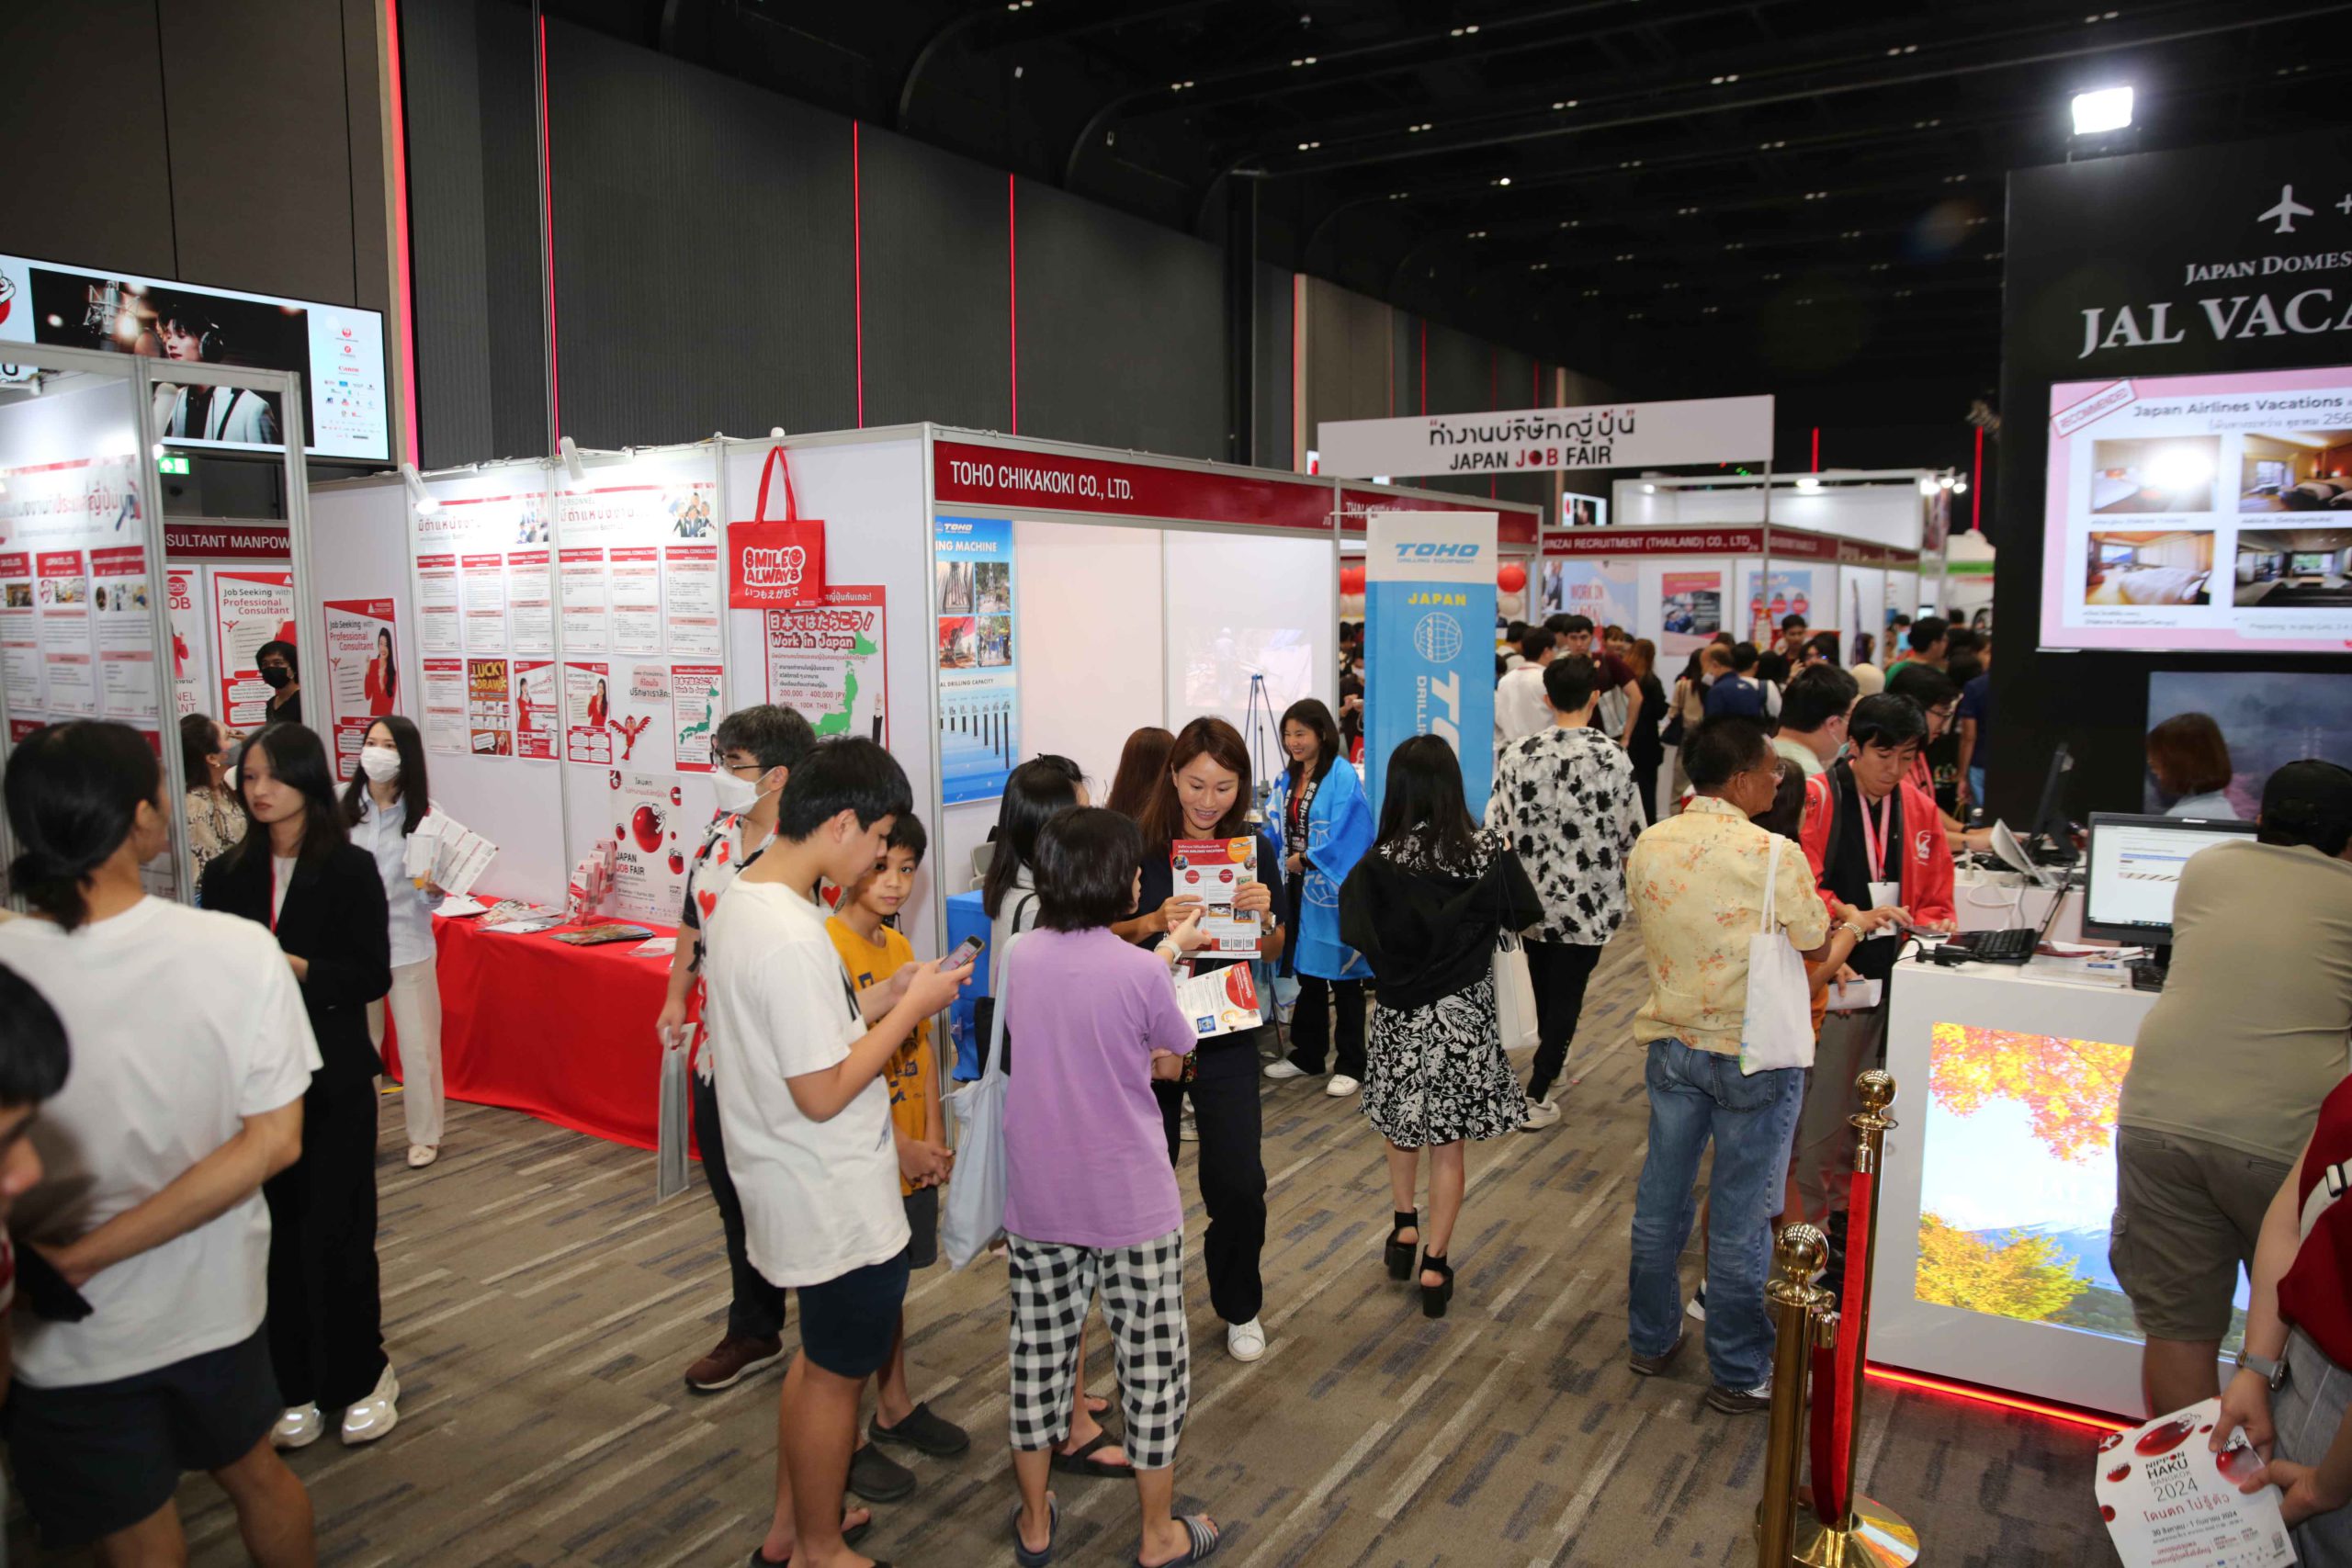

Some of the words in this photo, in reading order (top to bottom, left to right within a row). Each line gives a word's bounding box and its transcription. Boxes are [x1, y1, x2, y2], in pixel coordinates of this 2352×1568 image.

[2185, 261, 2256, 286] JAPAN
[2078, 302, 2185, 358] JAL
[2133, 404, 2182, 418] Japan
[2187, 400, 2251, 415] Airlines
[2256, 396, 2343, 412] Vacations
[1450, 452, 1509, 470] JAPAN
[1515, 448, 1559, 468] JOB
[1566, 446, 1612, 466] FAIR
[950, 461, 994, 487] TOHO
[998, 466, 1075, 495] CHIKAKOKI
[1079, 475, 1104, 501] CO.,
[1108, 479, 1134, 500] LTD.
[944, 523, 973, 531] TOHO
[956, 541, 997, 552] MACHINE
[1574, 536, 1644, 548] RECRUITMENT
[1645, 535, 1704, 550] (THAILAND)
[1395, 543, 1479, 557] TOHO
[223, 587, 239, 597] Job
[239, 588, 272, 598] Seeking
[275, 588, 291, 596] with
[745, 586, 798, 599] いつもえがおで
[1408, 592, 1467, 606] JAPAN
[169, 597, 192, 610] OB
[223, 597, 281, 607] Professional
[238, 606, 289, 615] Consultant
[329, 621, 339, 630] Job
[339, 620, 362, 630] Seeking
[329, 632, 368, 641] Professional
[770, 632, 801, 649] Work
[803, 633, 817, 649] in
[818, 632, 856, 652] Japan
[339, 641, 375, 651] Consultant
[472, 660, 505, 678] LUCKY
[477, 677, 502, 691] DRAW
[779, 689, 803, 697] 200,000
[809, 691, 833, 699] 400,000
[1416, 675, 1428, 736] DRILLIN
[1431, 671, 1461, 762] TO
[616, 852, 637, 863] JAPAN
[616, 864, 628, 874] JOB
[629, 866, 645, 875] FAIR
[2145, 1450, 2185, 1470] NIPPON
[2146, 1459, 2188, 1480] HAKU
[2150, 1471, 2192, 1487] BANGKOK
[2154, 1477, 2199, 1502] 2024
[2221, 1510, 2238, 1520] 2024
